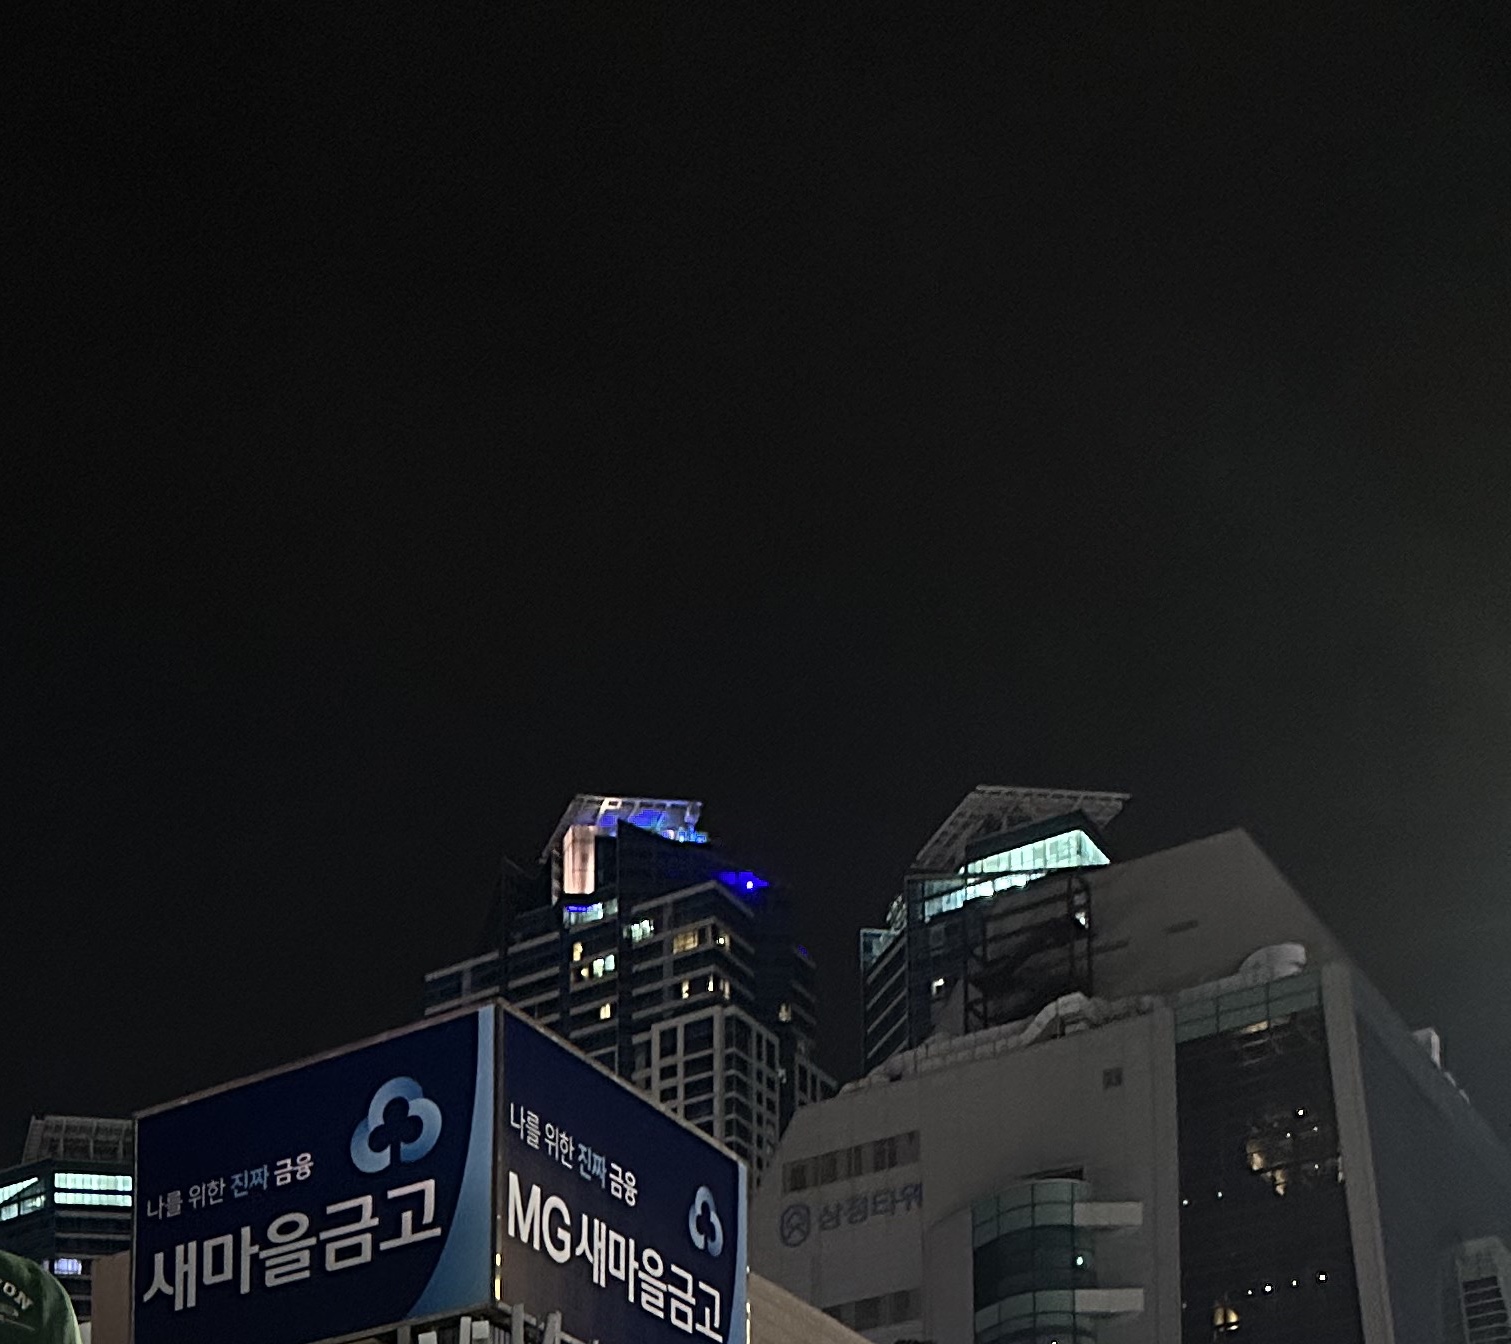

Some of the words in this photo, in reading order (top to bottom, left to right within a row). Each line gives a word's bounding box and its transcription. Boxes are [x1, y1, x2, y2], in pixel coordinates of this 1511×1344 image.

[146, 1190, 183, 1220] 나를
[188, 1177, 226, 1209] 위한
[230, 1164, 269, 1198] 진짜
[274, 1152, 314, 1186] 금융
[510, 1102, 541, 1150] 나를
[544, 1123, 575, 1169] 위한
[577, 1143, 608, 1189] 진짜
[609, 1163, 638, 1207] 금융
[142, 1179, 442, 1311] 새마을금고
